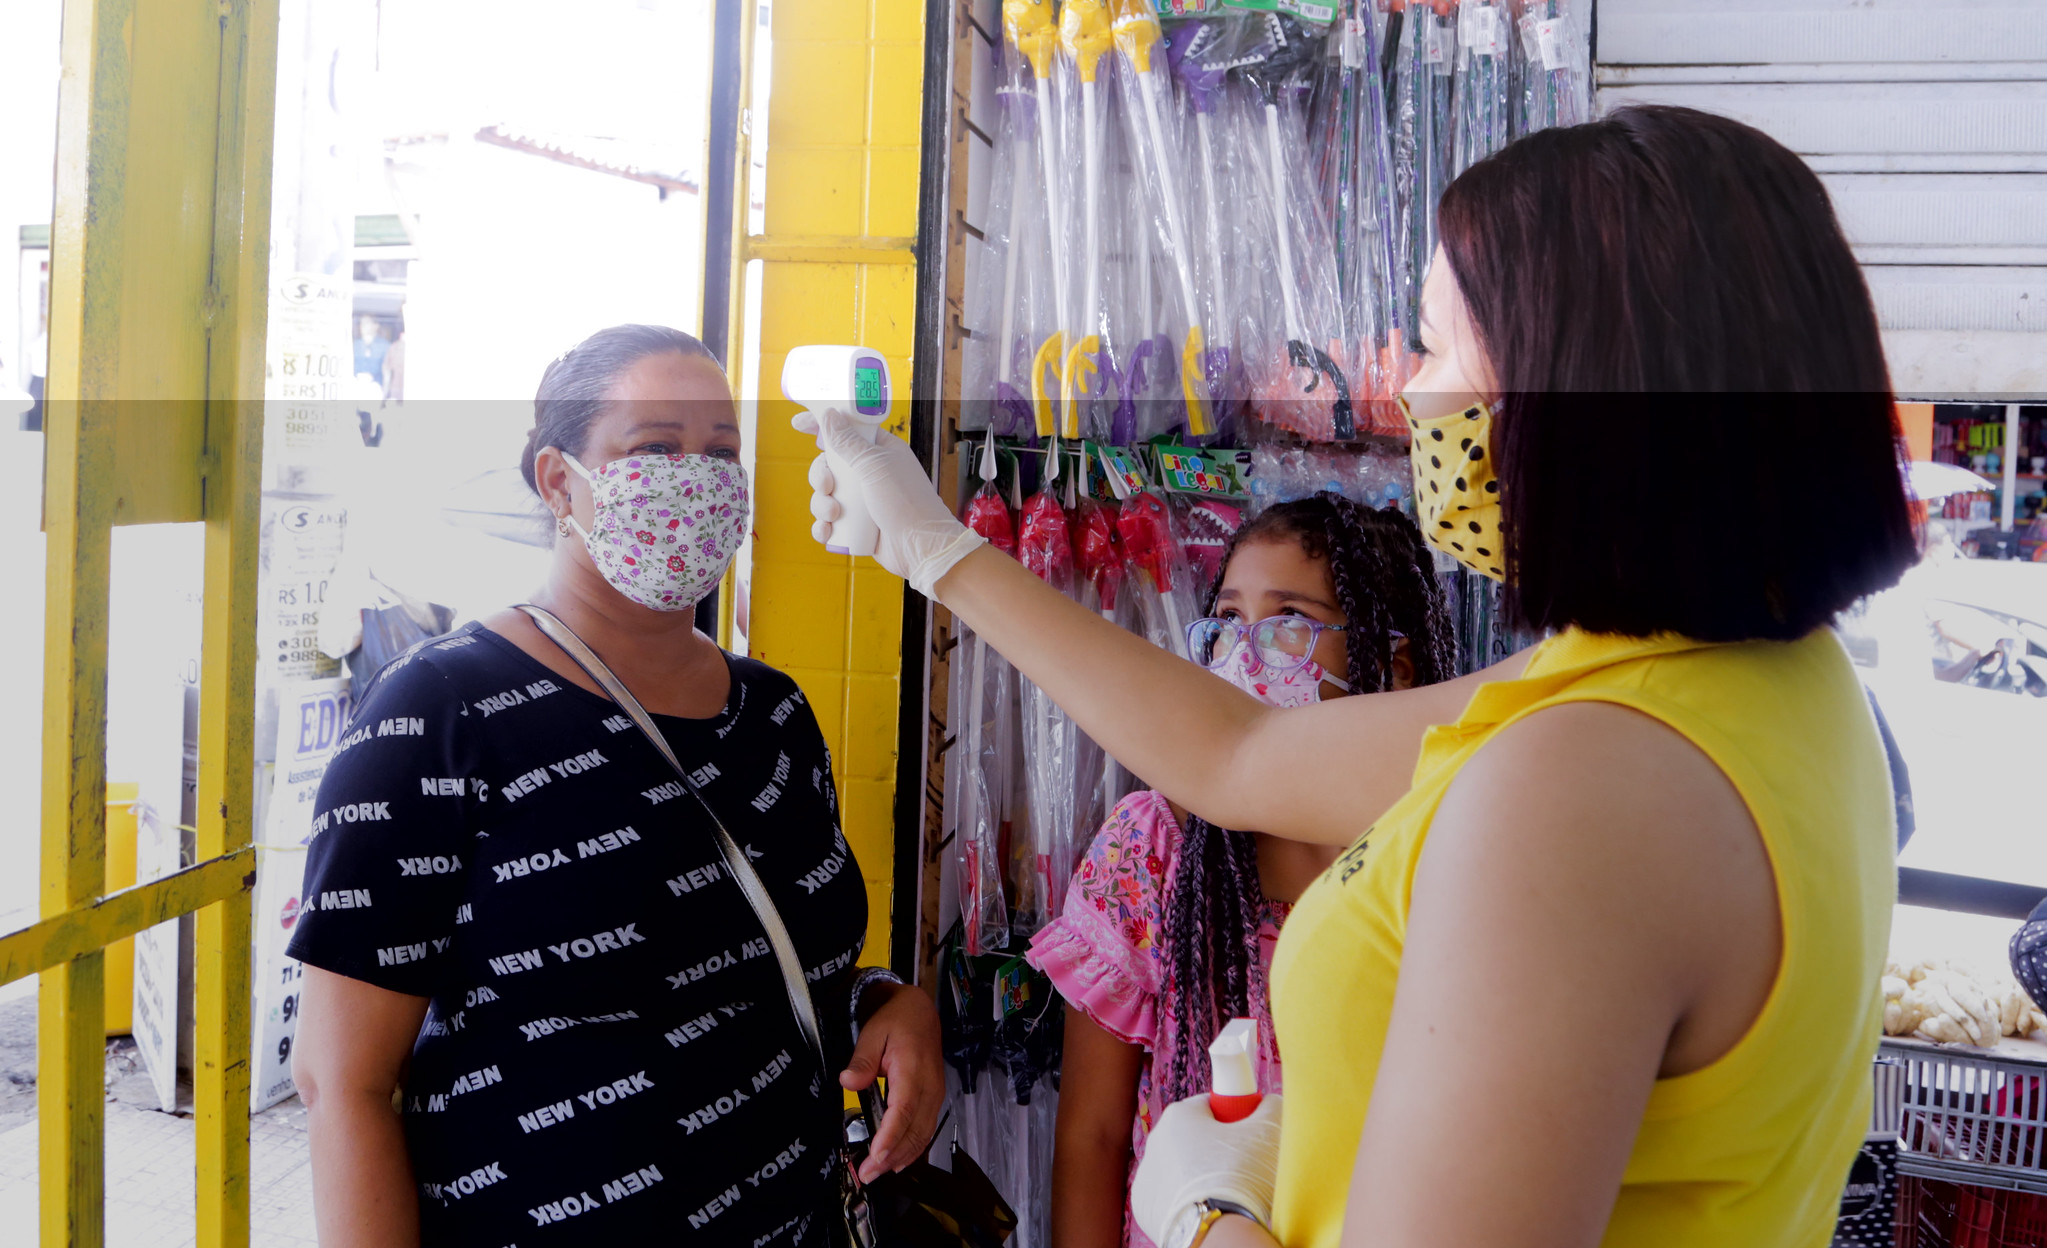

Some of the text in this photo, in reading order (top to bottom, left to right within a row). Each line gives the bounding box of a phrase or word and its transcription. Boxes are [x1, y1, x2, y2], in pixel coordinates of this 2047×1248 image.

[1162, 453, 1205, 473] Dino
[1174, 470, 1226, 494] Legal
[473, 678, 563, 718] YORK EW
[769, 697, 796, 727] NEW
[376, 717, 425, 736] NEW
[601, 713, 636, 734] NE
[501, 748, 610, 804] NEW YORK
[750, 749, 791, 813] NEW YORK
[332, 801, 393, 825] YORK
[396, 854, 463, 877] YORK
[491, 826, 642, 884] YORK NEW
[795, 851, 846, 895] YORK
[665, 863, 722, 897] NEW
[320, 889, 373, 911] NEW
[377, 941, 427, 967] NEW
[488, 922, 647, 976] NEW YORK
[664, 936, 771, 991] YORK EW
[804, 948, 852, 984] NEW
[518, 1016, 583, 1042] YORK
[663, 1011, 719, 1048] NEW
[451, 1064, 503, 1097] NEW
[677, 1048, 792, 1136] YORK NEW
[517, 1070, 656, 1134] NEW YORK
[443, 1160, 508, 1201] YORK
[527, 1163, 665, 1227] YORK NEW
[686, 1136, 808, 1230] NEW YORK
